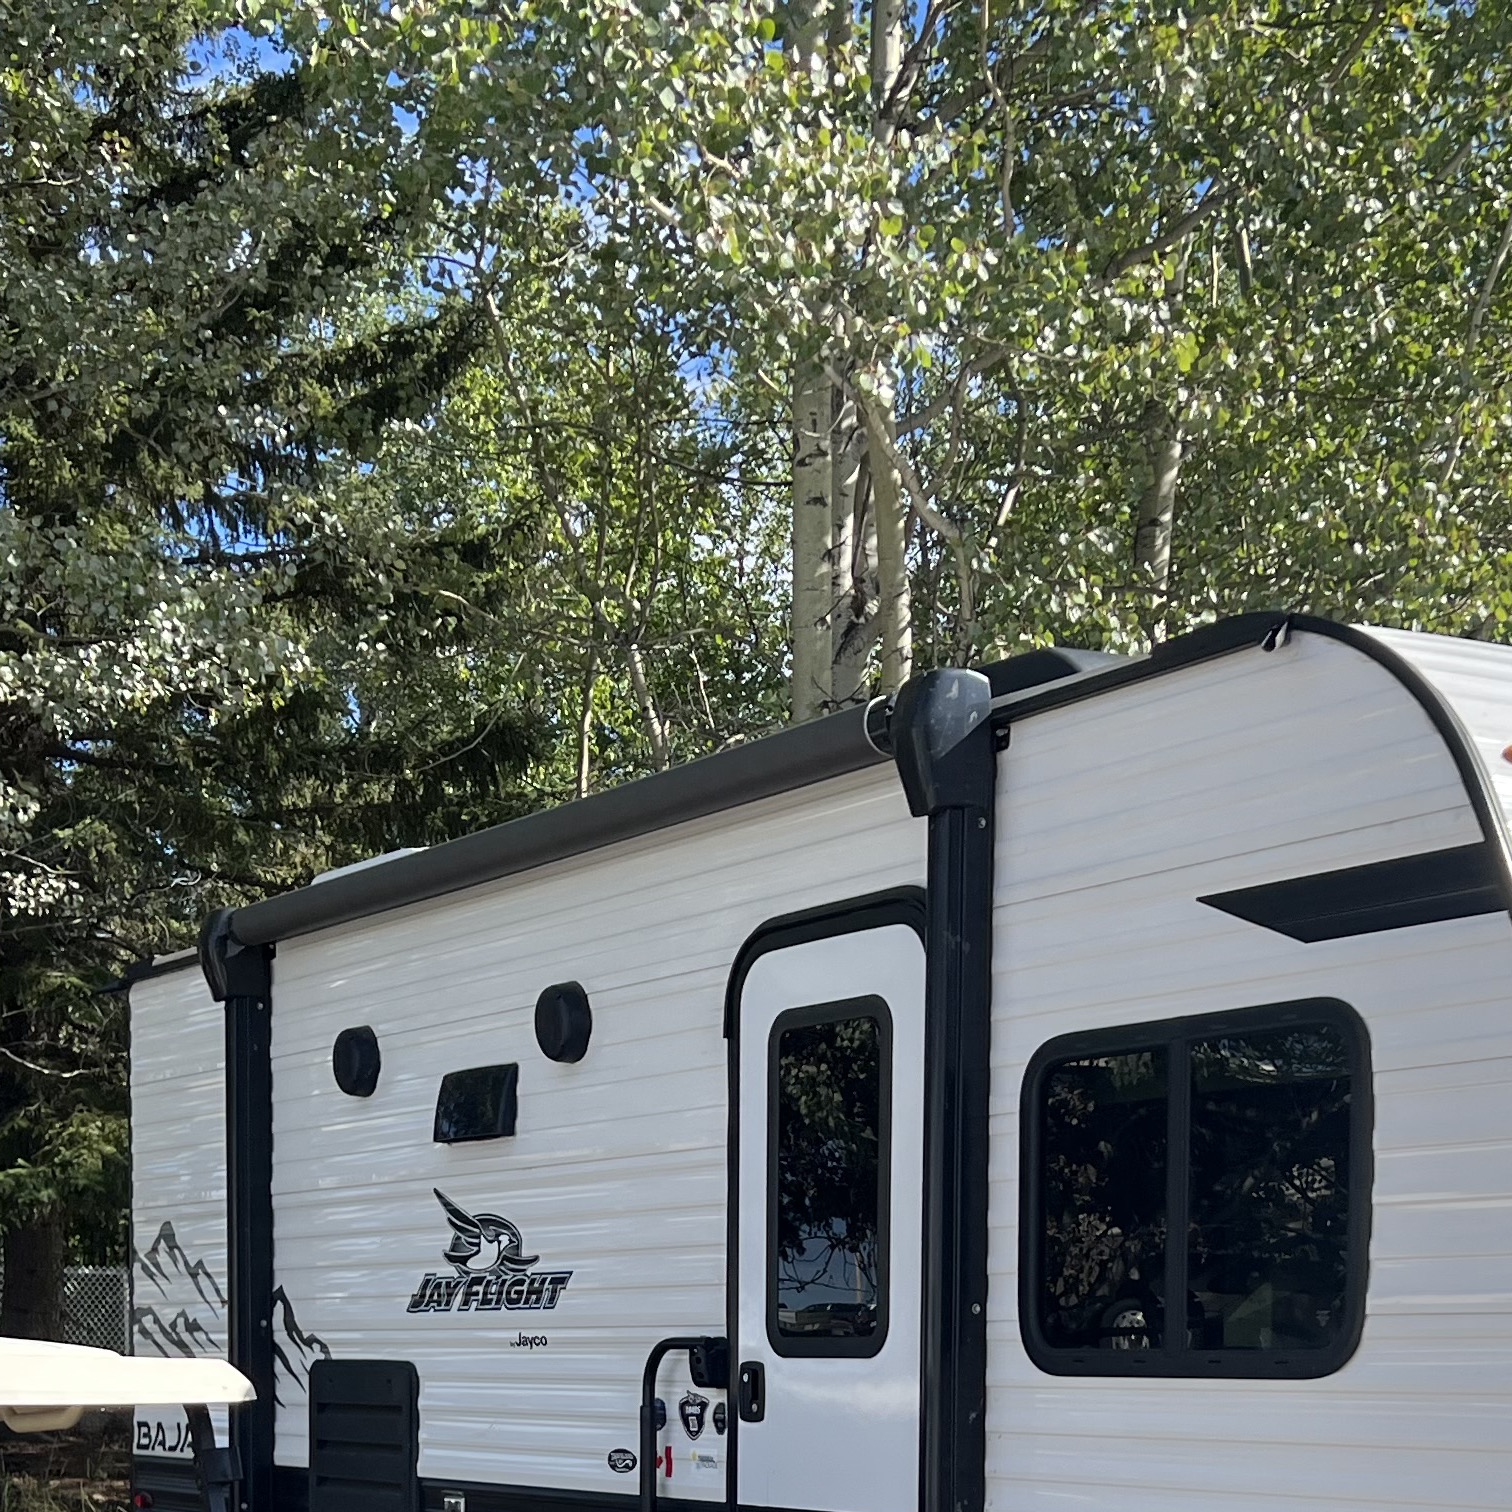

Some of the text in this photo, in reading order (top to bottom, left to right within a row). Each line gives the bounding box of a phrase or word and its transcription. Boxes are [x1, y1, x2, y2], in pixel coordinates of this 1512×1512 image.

[406, 1271, 573, 1313] JAY FLIGHT
[515, 1332, 548, 1349] Jayco
